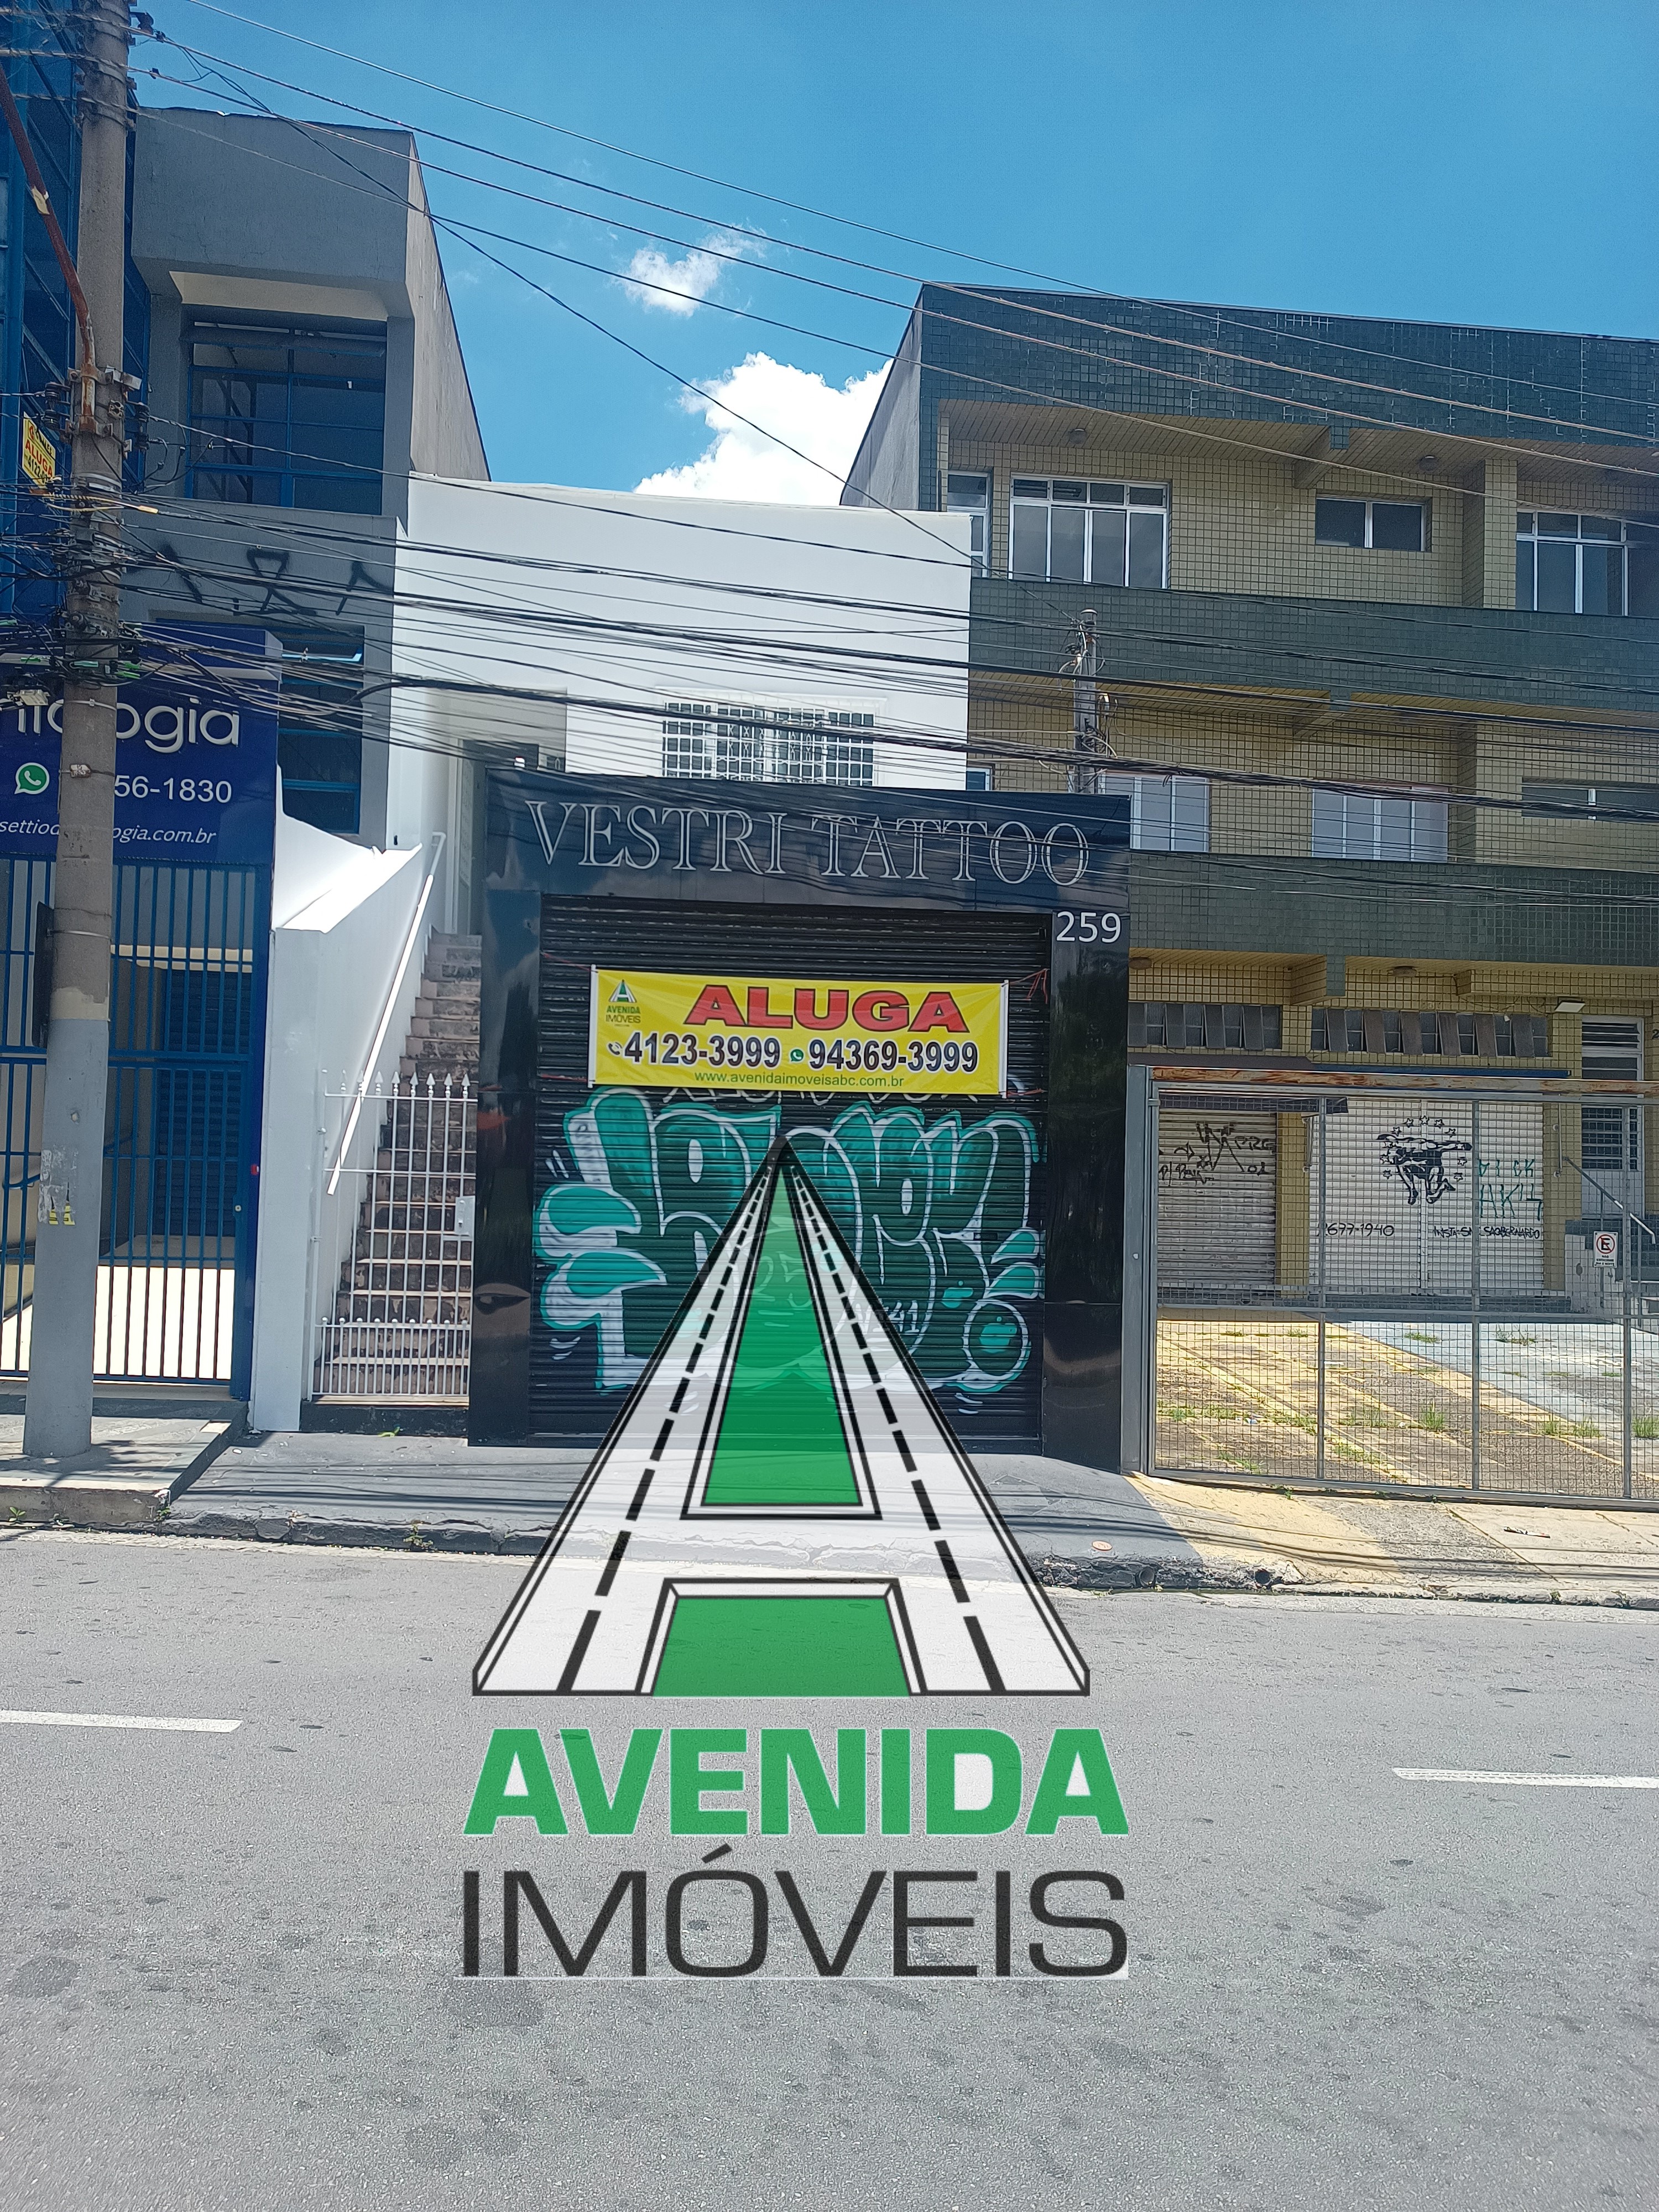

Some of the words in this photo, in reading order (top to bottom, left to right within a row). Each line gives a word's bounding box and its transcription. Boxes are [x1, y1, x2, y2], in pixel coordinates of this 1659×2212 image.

[25, 439, 53, 478] ALUGA
[525, 800, 787, 876] VESTRI
[811, 814, 1090, 885] TATTOO
[1056, 911, 1121, 943] 259
[606, 1014, 641, 1024] IMÓVEIS
[607, 1005, 641, 1014] AVENIDA
[683, 984, 971, 1033] ALUGA
[624, 1031, 781, 1068] 4123-3999
[808, 1039, 979, 1073] 94369-3999
[694, 1071, 904, 1087] www.avenidaimoveisabc.com.br
[1316, 1223, 1395, 1237] 677-1940
